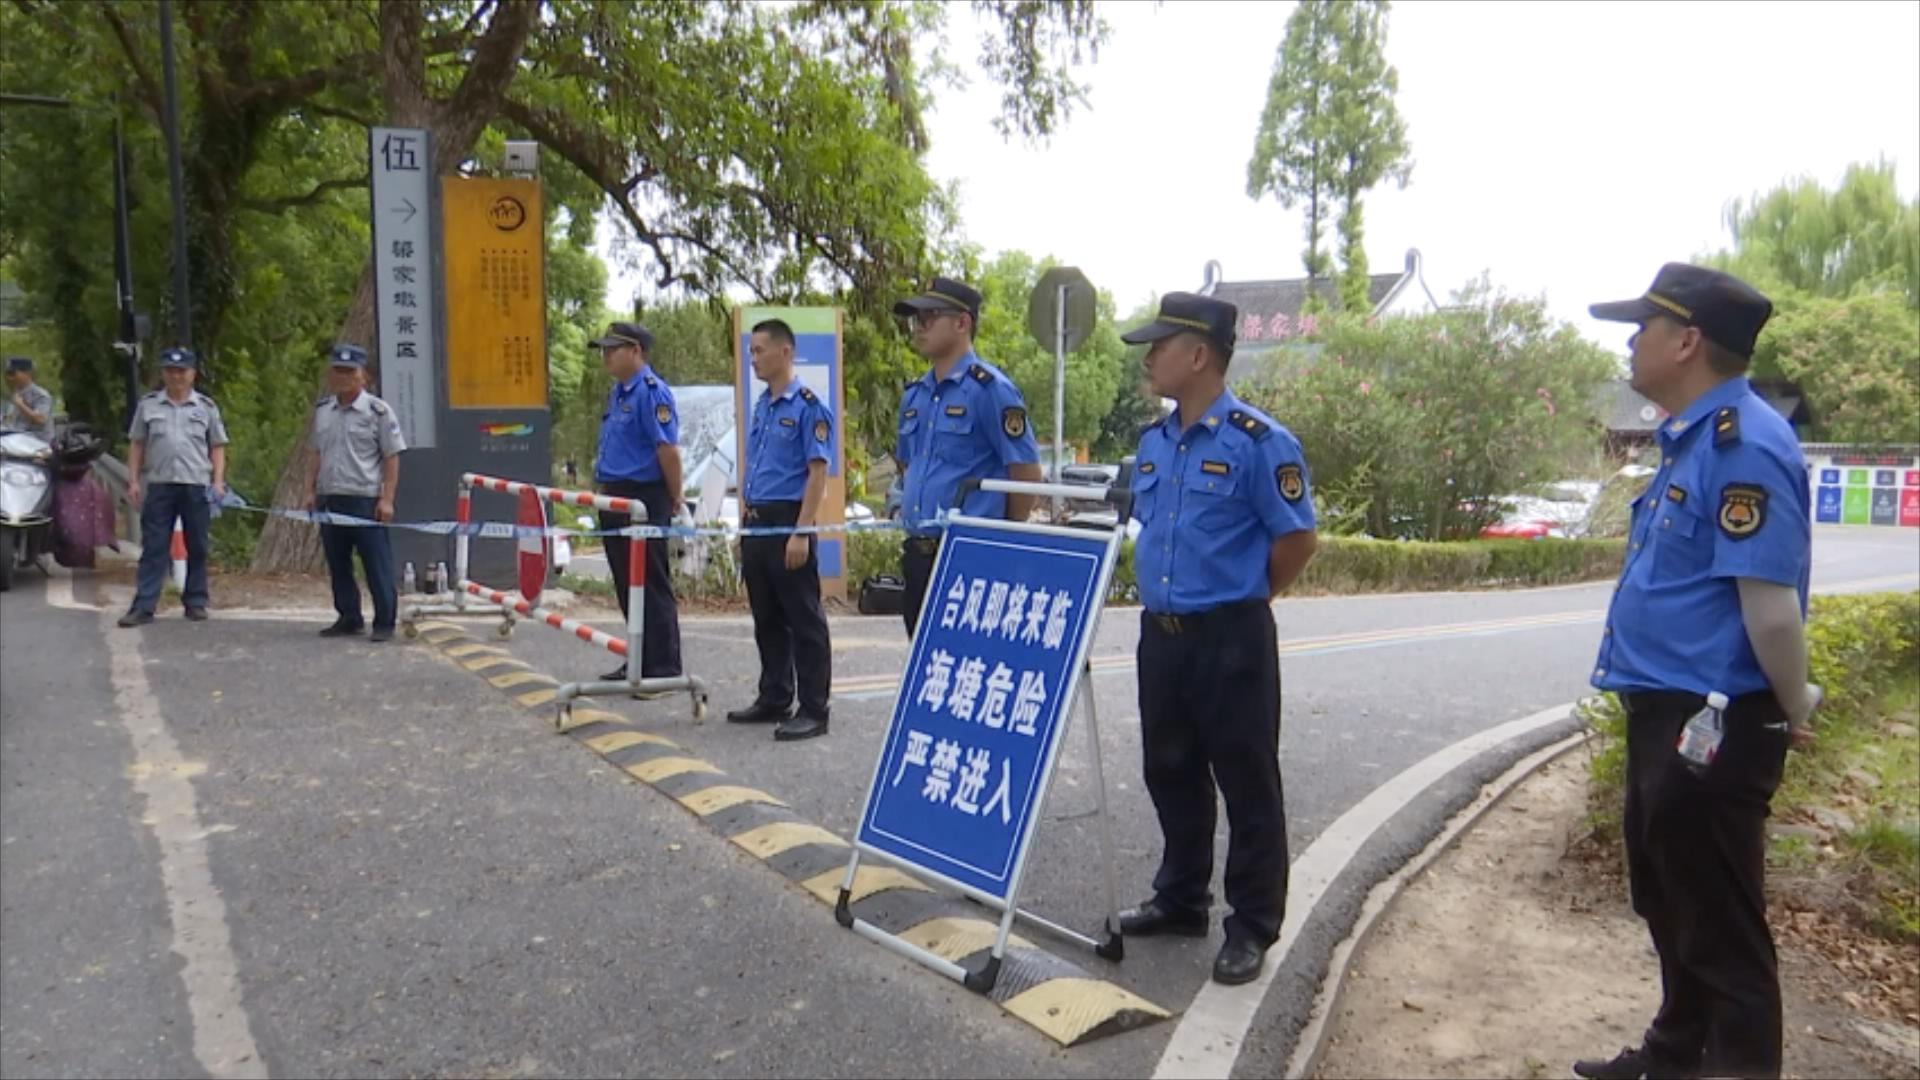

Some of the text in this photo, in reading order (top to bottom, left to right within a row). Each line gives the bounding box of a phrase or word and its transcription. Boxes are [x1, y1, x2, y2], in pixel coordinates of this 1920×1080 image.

[381, 133, 420, 171] 伍
[940, 573, 1073, 651] 台风即将来临
[917, 647, 1047, 737] 海塘危险
[893, 729, 1012, 825] 严禁进入
